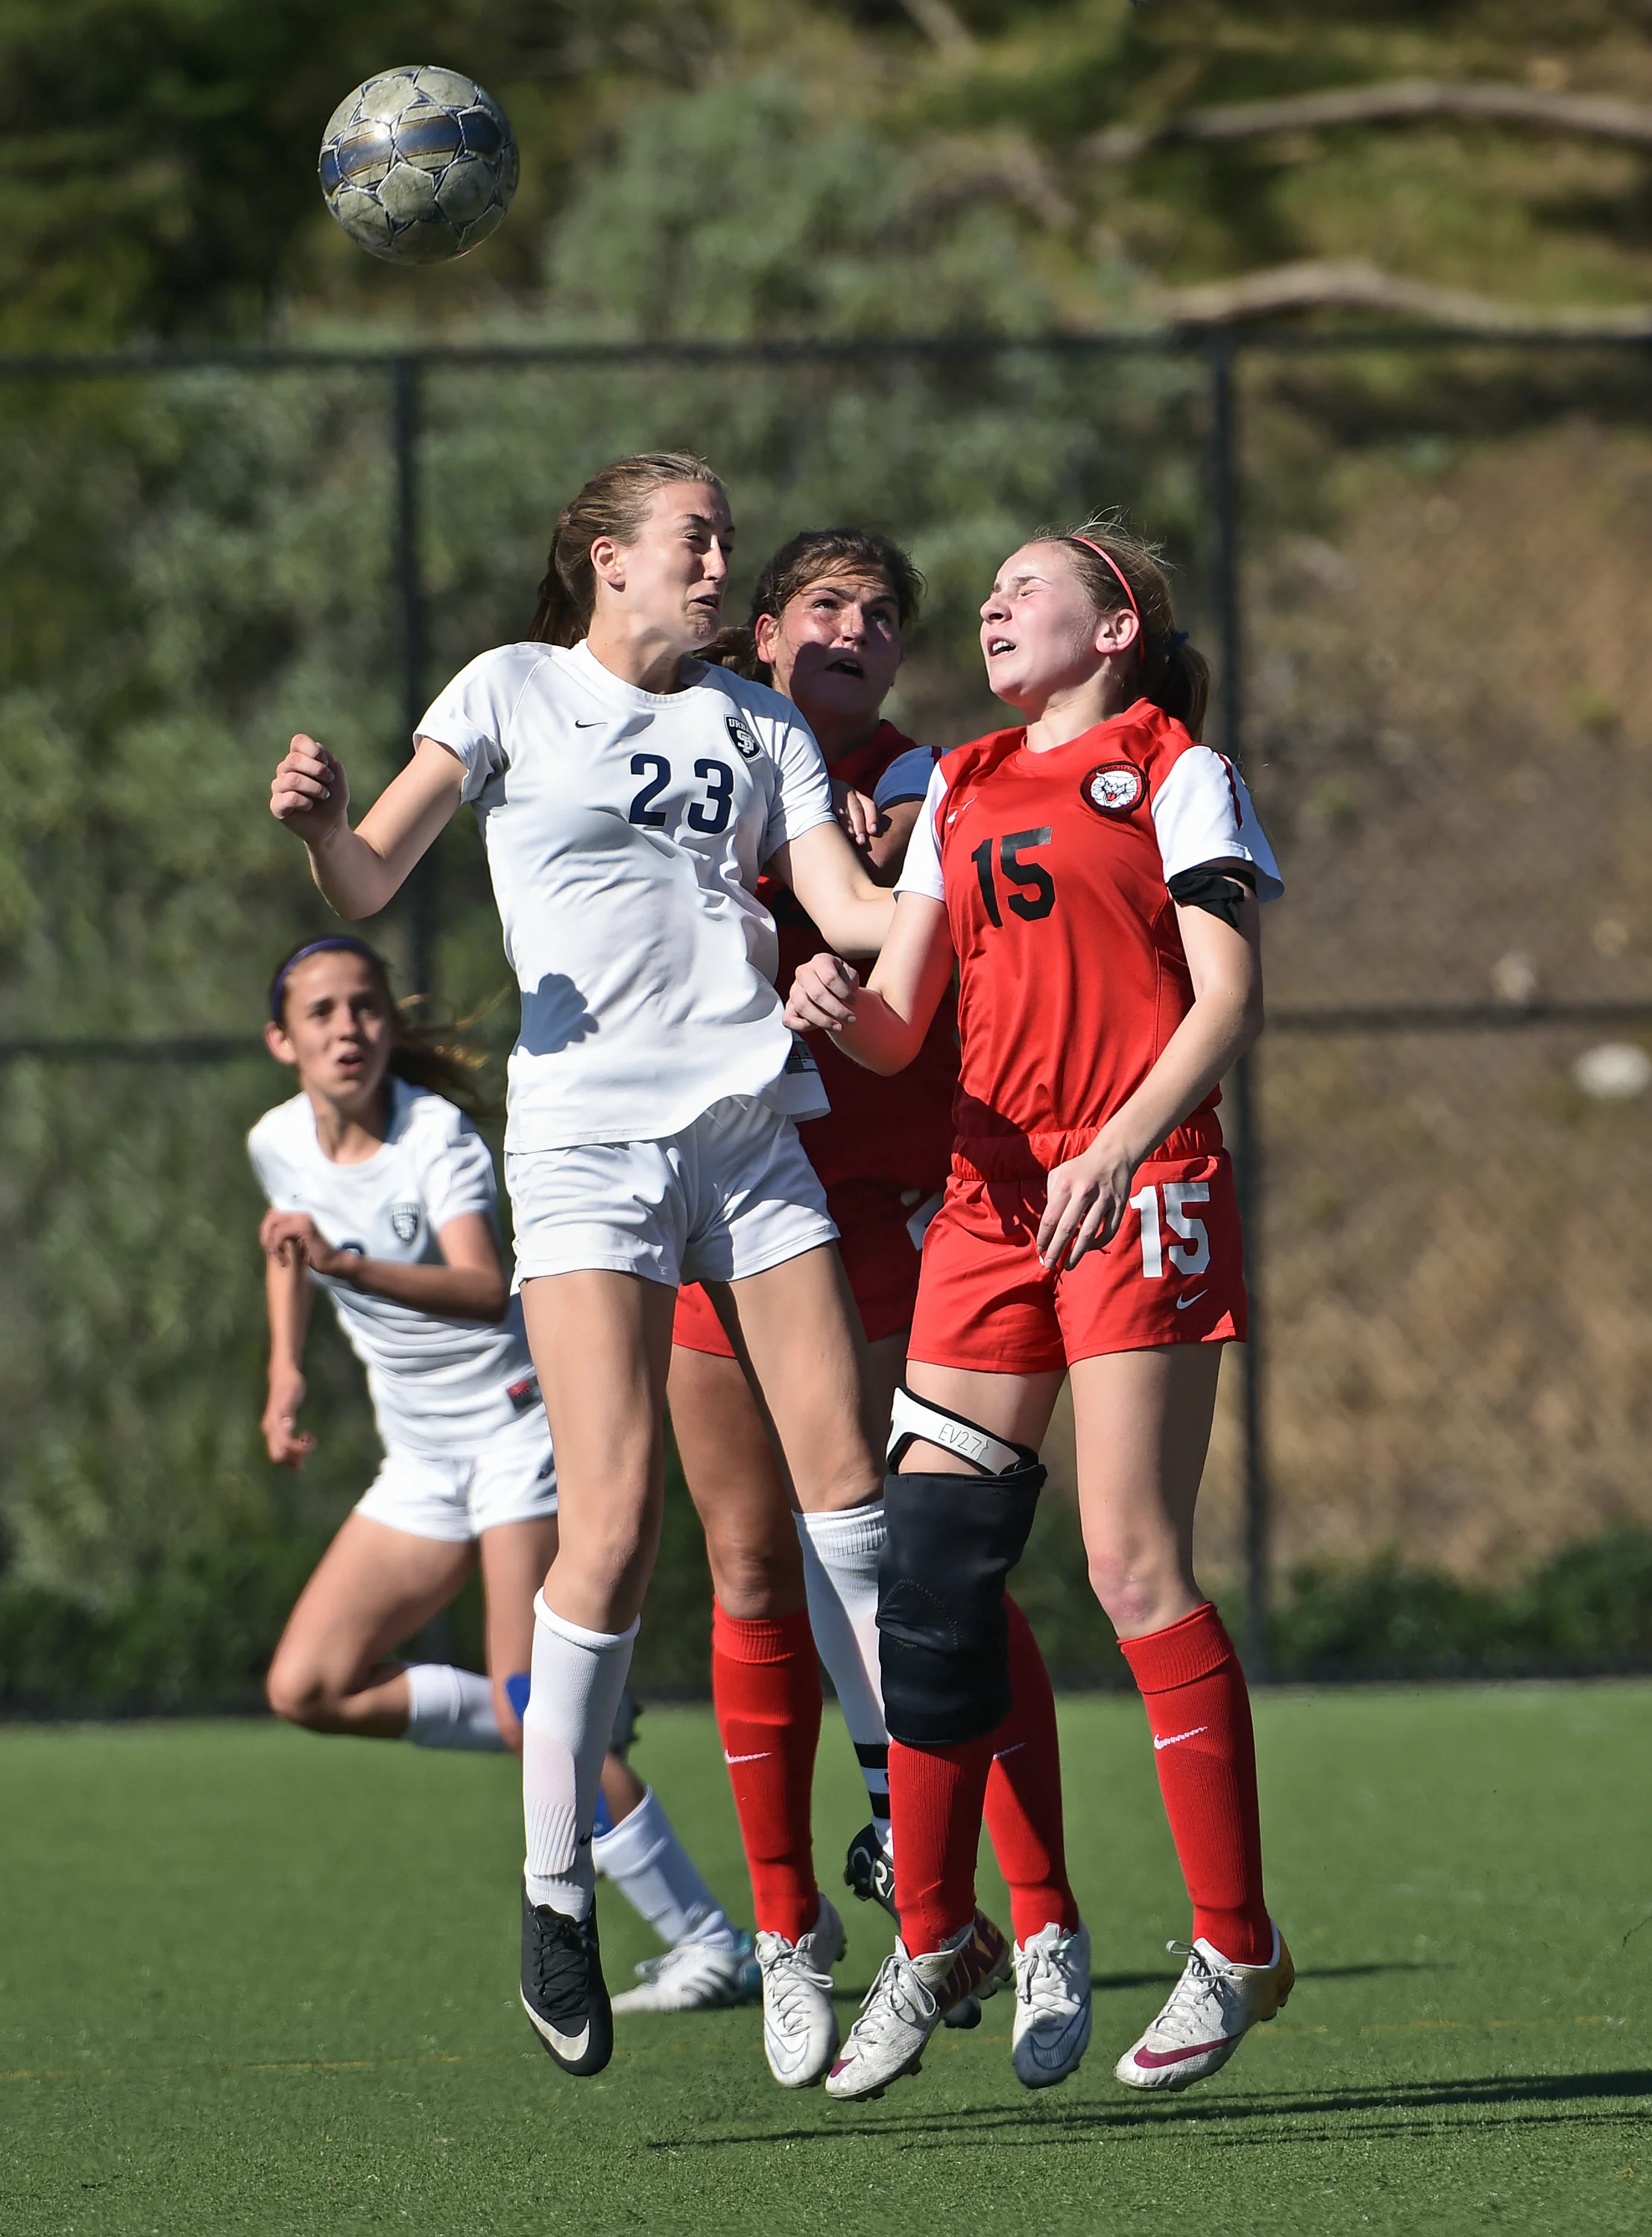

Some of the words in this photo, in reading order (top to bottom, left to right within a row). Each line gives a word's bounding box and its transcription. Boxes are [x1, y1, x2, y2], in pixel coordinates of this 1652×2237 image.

[728, 718, 749, 733] URB
[628, 753, 734, 834] 23
[971, 825, 1056, 928] 15
[1129, 1182, 1211, 1278] 15
